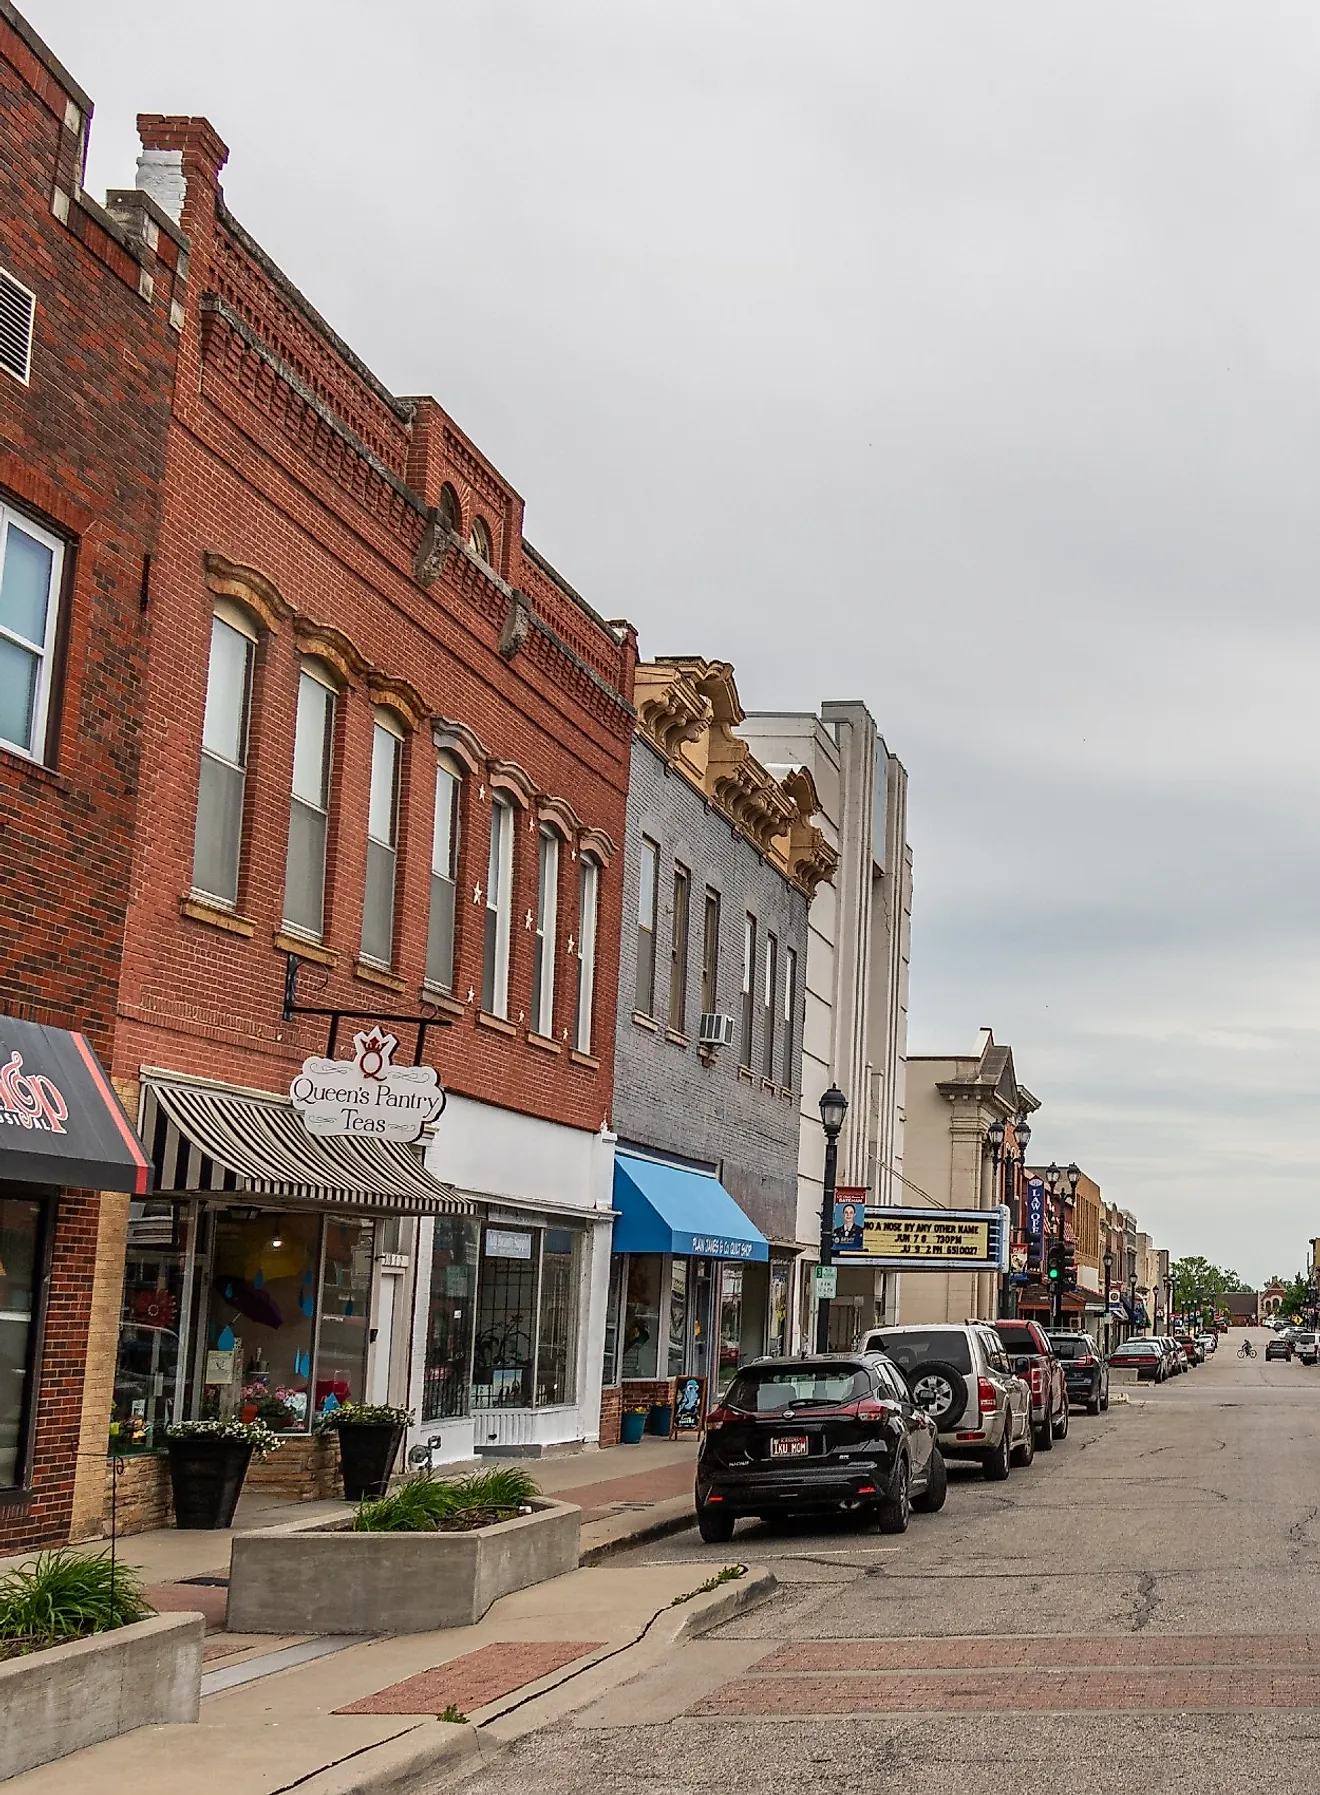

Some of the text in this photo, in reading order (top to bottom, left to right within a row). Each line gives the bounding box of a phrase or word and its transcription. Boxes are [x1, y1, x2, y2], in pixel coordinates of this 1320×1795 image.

[359, 1050, 388, 1082] Q
[293, 1077, 440, 1119] Queen's Pantry
[340, 1108, 386, 1133] Teas
[1030, 1189, 1041, 1211] LAW
[884, 1223, 902, 1232] NOSE
[904, 1223, 915, 1233] BY
[916, 1223, 932, 1233] ANY
[934, 1224, 956, 1233] OTHER
[958, 1225, 979, 1235] NAME
